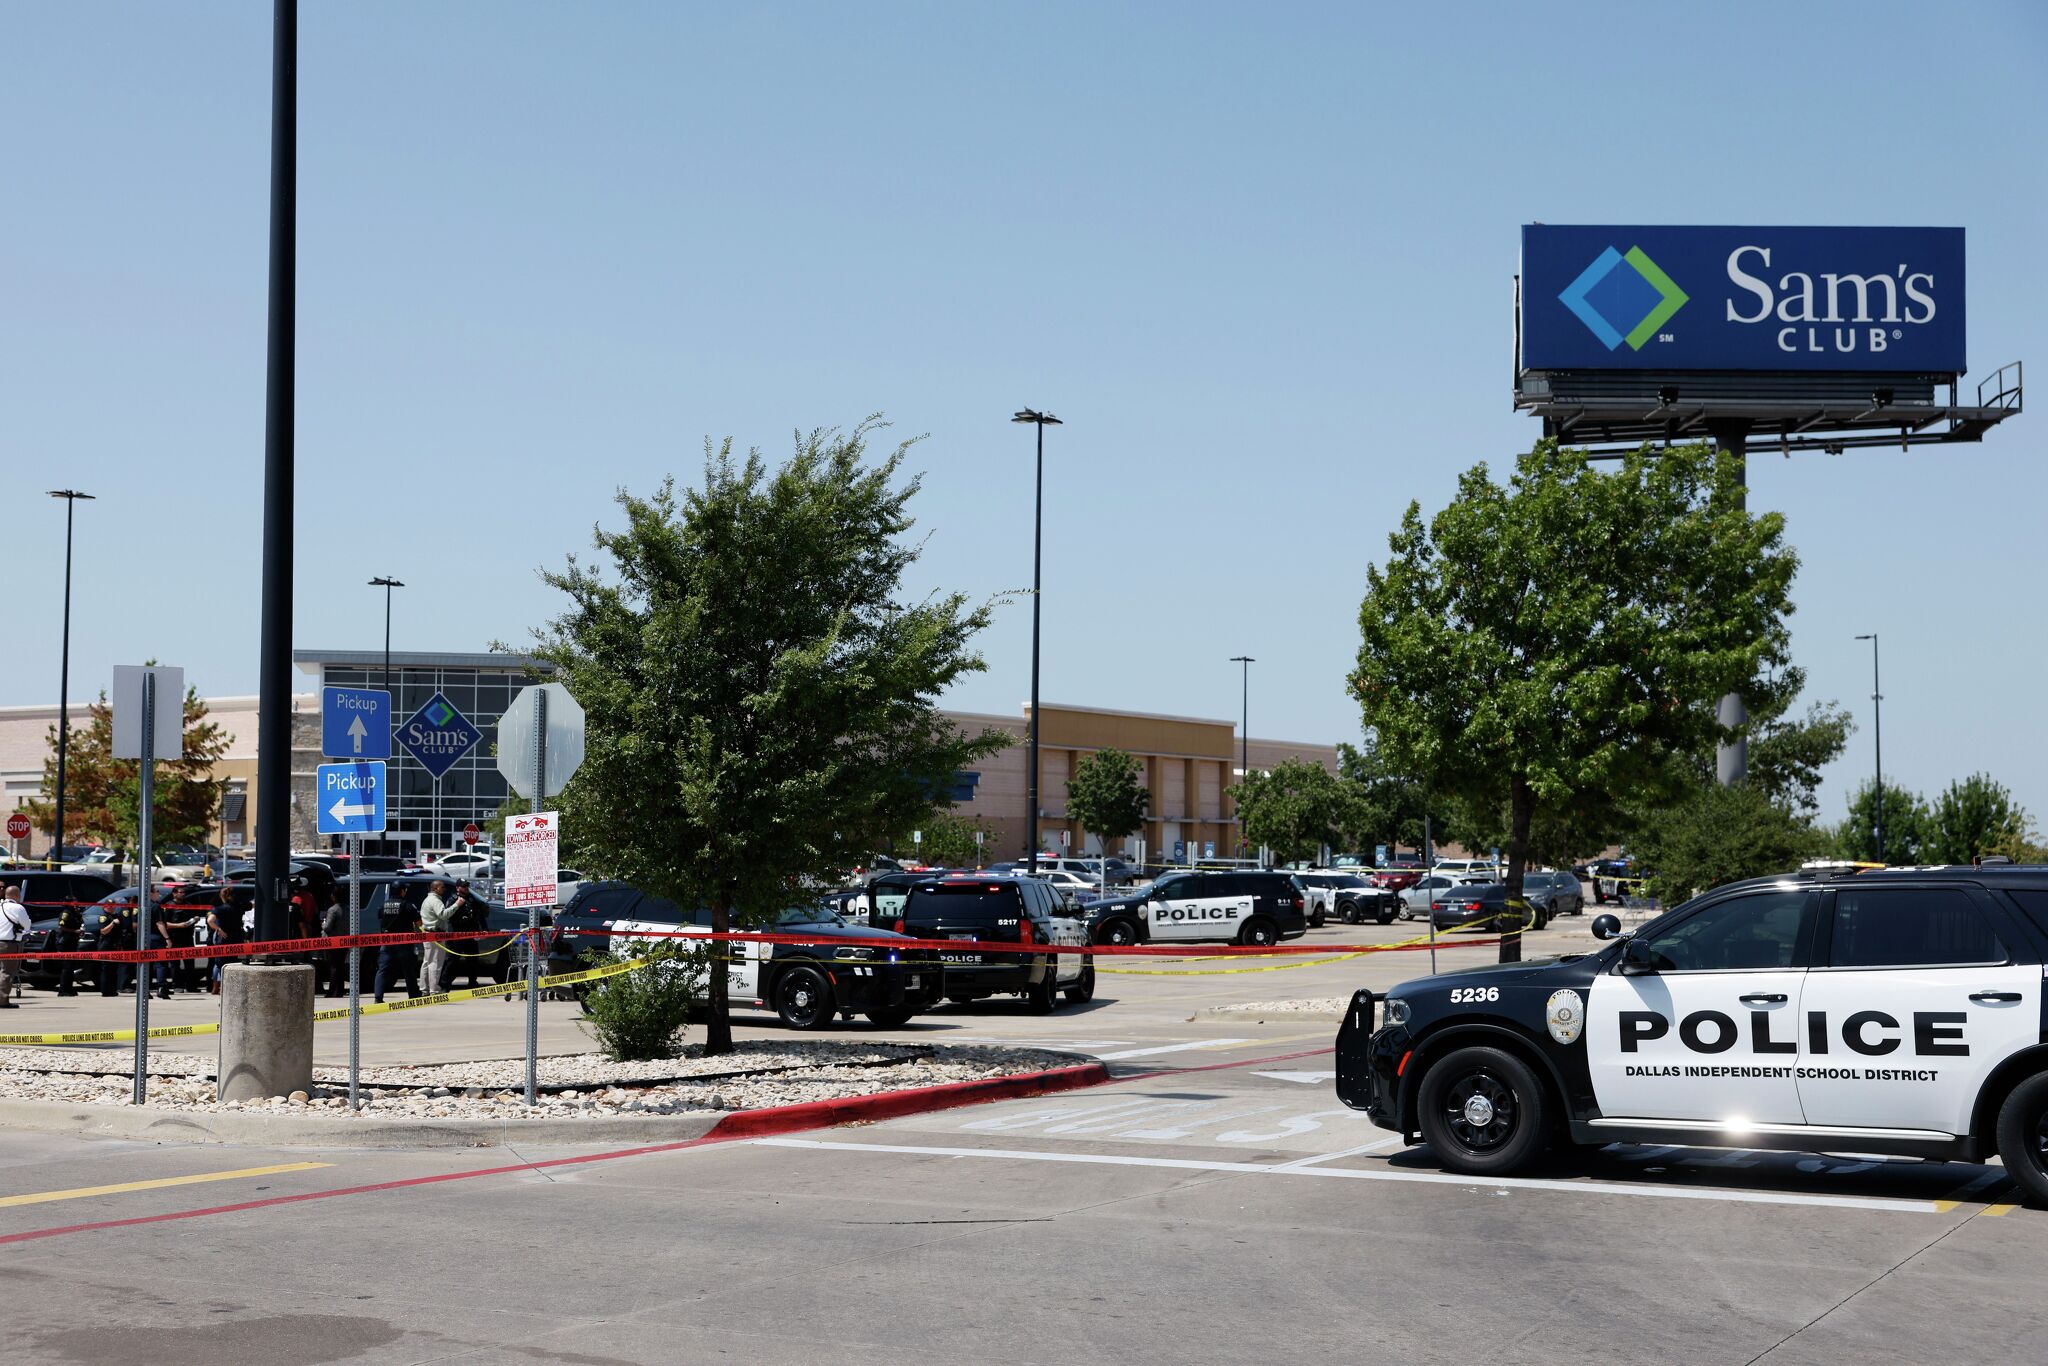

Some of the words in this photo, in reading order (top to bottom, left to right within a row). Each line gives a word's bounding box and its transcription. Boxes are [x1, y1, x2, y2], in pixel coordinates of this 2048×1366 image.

[1726, 245, 1936, 324] Sam's
[336, 693, 377, 715] Pickup
[408, 722, 468, 746] Sam's
[327, 772, 376, 794] Pickup
[483, 810, 498, 818] Exit
[8, 821, 30, 832] STOP
[464, 830, 478, 839] STOP
[507, 833, 528, 843] TOWING
[530, 830, 555, 841] ENFORCED
[1156, 908, 1238, 921] POLICE
[252, 945, 270, 953] CRIME
[271, 943, 290, 951] SCENE
[300, 940, 311, 948] NOT
[313, 938, 332, 947] CROSS
[340, 938, 358, 946] CRIME
[360, 937, 380, 945] SCENE
[406, 933, 426, 941] CROSS
[140, 951, 158, 960] CROSS
[166, 950, 183, 959] CRIME
[185, 949, 202, 958] SCENE
[213, 946, 224, 954] NOT
[226, 945, 244, 954] CROSS
[577, 972, 587, 980] CROSS
[472, 988, 486, 997] POLICE
[487, 986, 495, 995] LINE
[512, 982, 525, 991] CROSS
[1450, 987, 1500, 1003] 5236
[1552, 990, 1578, 1000] POLICE
[389, 1001, 405, 1010] POLICE
[406, 999, 415, 1008] LINE
[416, 998, 423, 1006] DO
[424, 997, 433, 1005] NOT
[433, 994, 449, 1004] CROSS
[319, 1011, 329, 1020] LINE
[338, 1009, 347, 1017] NOT
[348, 1007, 364, 1016] CSS
[177, 1026, 192, 1035] CROSS
[1619, 1010, 1970, 1056] POLICE
[1626, 1066, 1680, 1077] DALLAS
[1685, 1066, 1792, 1078] INDEPENDENT
[1796, 1068, 1860, 1079] SCHOOL
[1865, 1069, 1938, 1081] DISTRICT
